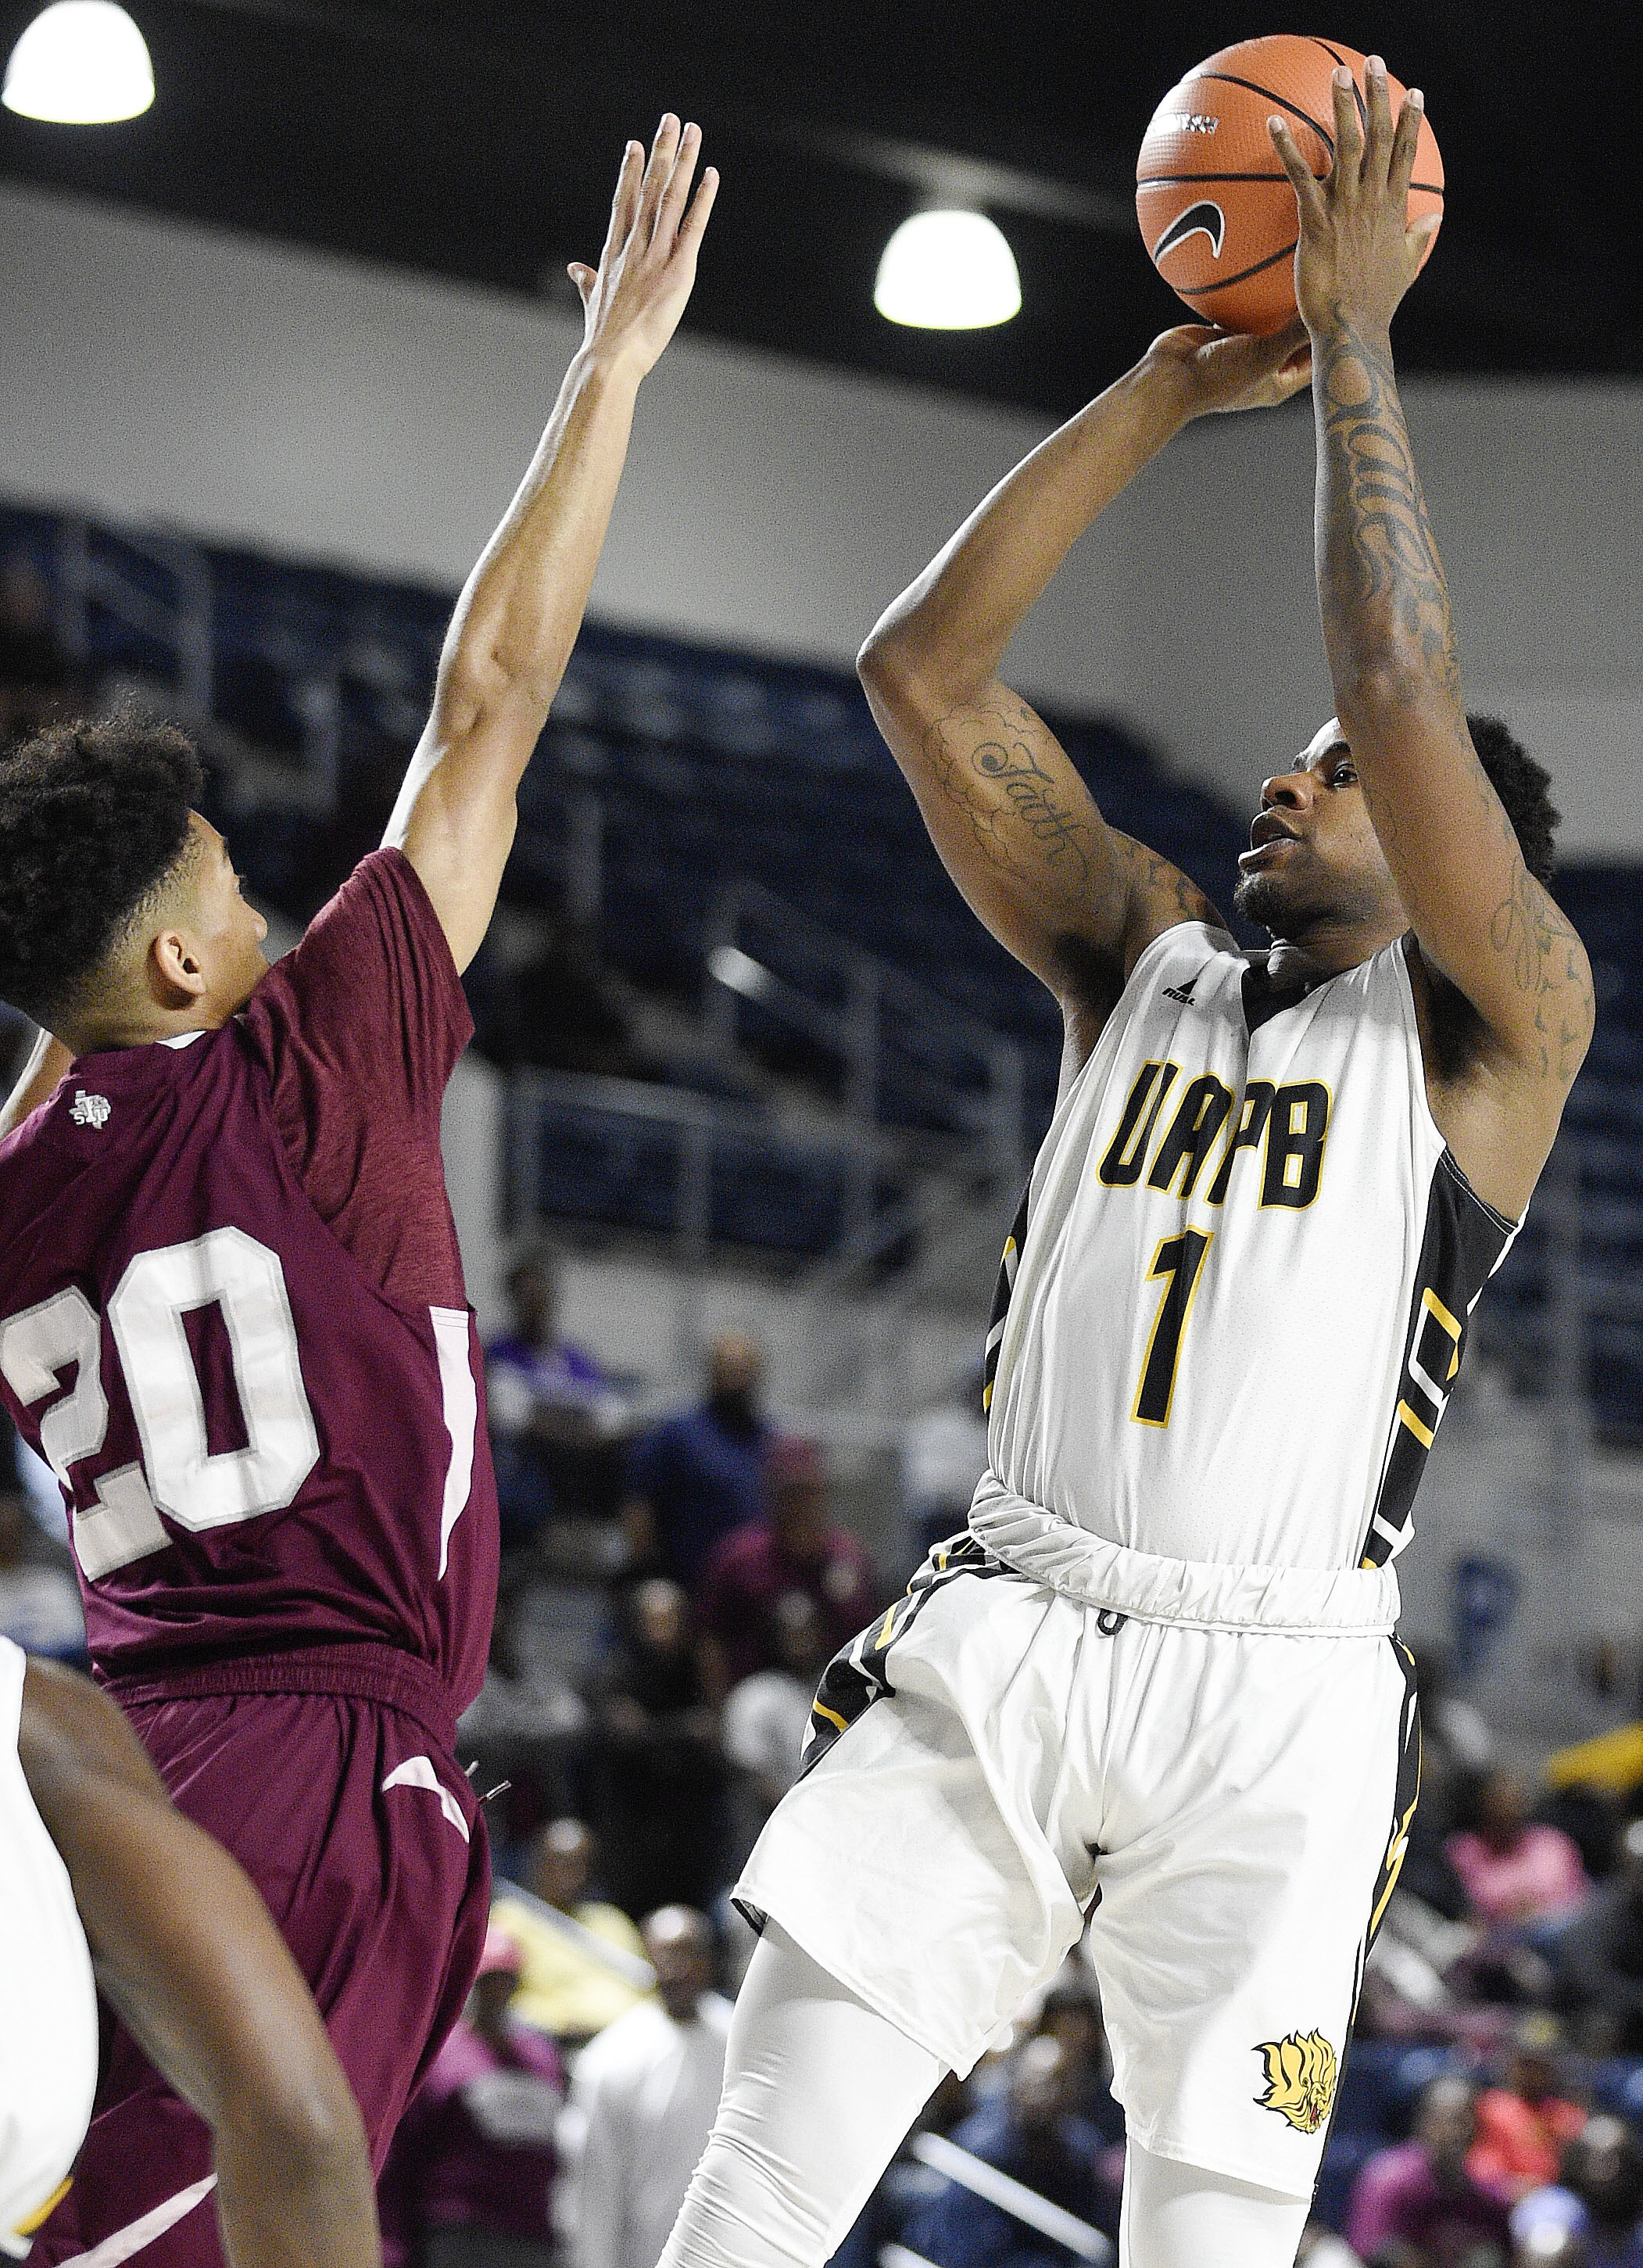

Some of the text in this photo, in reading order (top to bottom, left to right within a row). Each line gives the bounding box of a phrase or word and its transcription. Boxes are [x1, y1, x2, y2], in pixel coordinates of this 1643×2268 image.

[1097, 1059, 1333, 1213] UAPB
[0, 1226, 321, 1583] 20
[1129, 1225, 1215, 1429] 1
